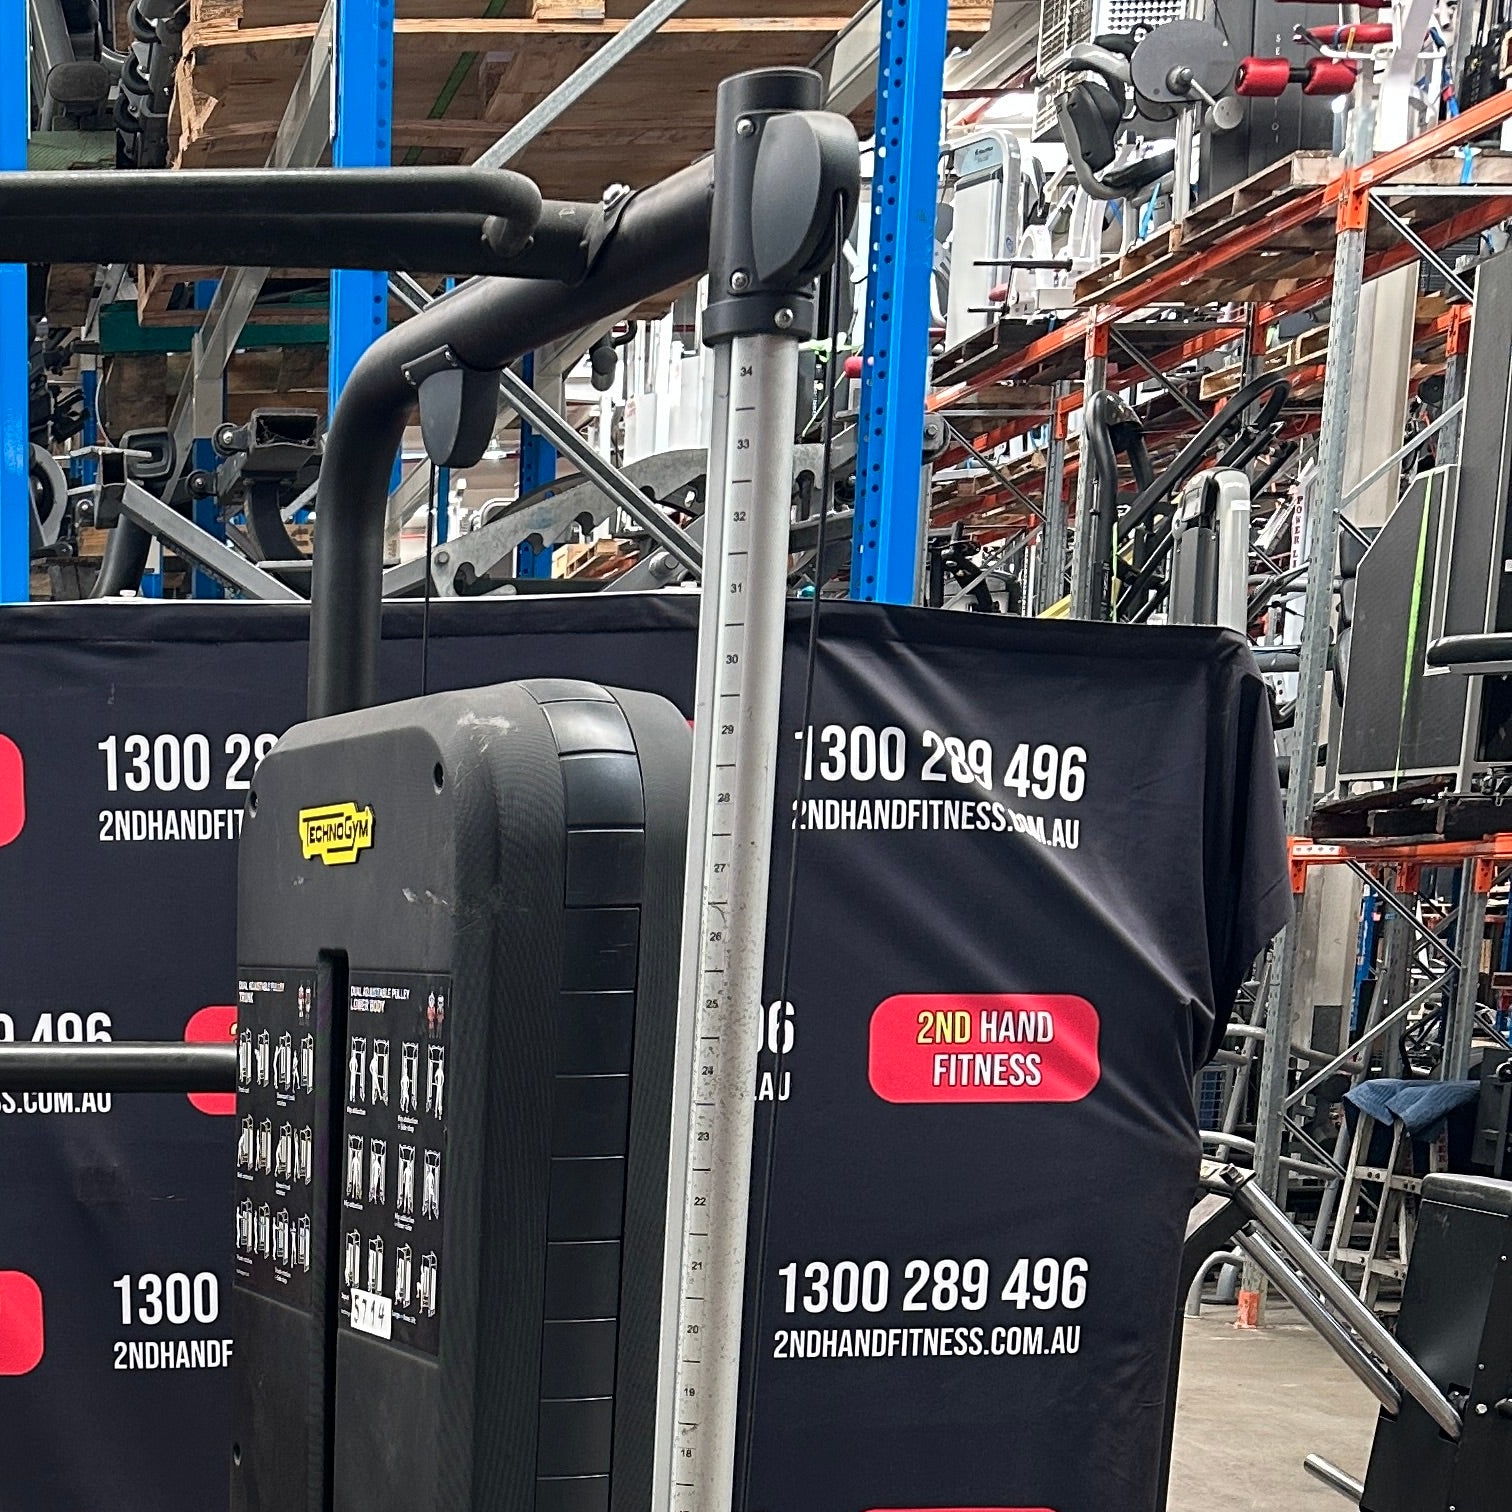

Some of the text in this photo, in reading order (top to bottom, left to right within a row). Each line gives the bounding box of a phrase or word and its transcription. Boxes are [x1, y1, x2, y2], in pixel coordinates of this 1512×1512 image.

[740, 367, 753, 377] 34
[737, 439, 750, 449] 33
[733, 512, 746, 521] 32
[730, 583, 743, 593] 31
[726, 654, 738, 664] 30
[721, 725, 734, 735] 29
[98, 734, 210, 792] 1300
[794, 723, 1088, 802] 1300 289 496
[718, 793, 730, 803] 28
[714, 863, 727, 873] 27
[709, 932, 722, 941] 26
[706, 999, 719, 1008] 25
[917, 1010, 1054, 1044] 2ND HAND
[701, 1066, 714, 1076] 24
[932, 1053, 1042, 1087] FITNESS
[697, 1132, 710, 1141] 23
[694, 1197, 706, 1206] 22
[691, 1261, 703, 1270] 21
[778, 1256, 1090, 1314] 1300 289 496
[113, 1272, 219, 1325] 1300
[687, 1325, 699, 1334] 20
[773, 1324, 1081, 1359] 2NDHANDFITNESS.COM.AU
[684, 1387, 695, 1396] 19
[681, 1448, 692, 1457] 18
